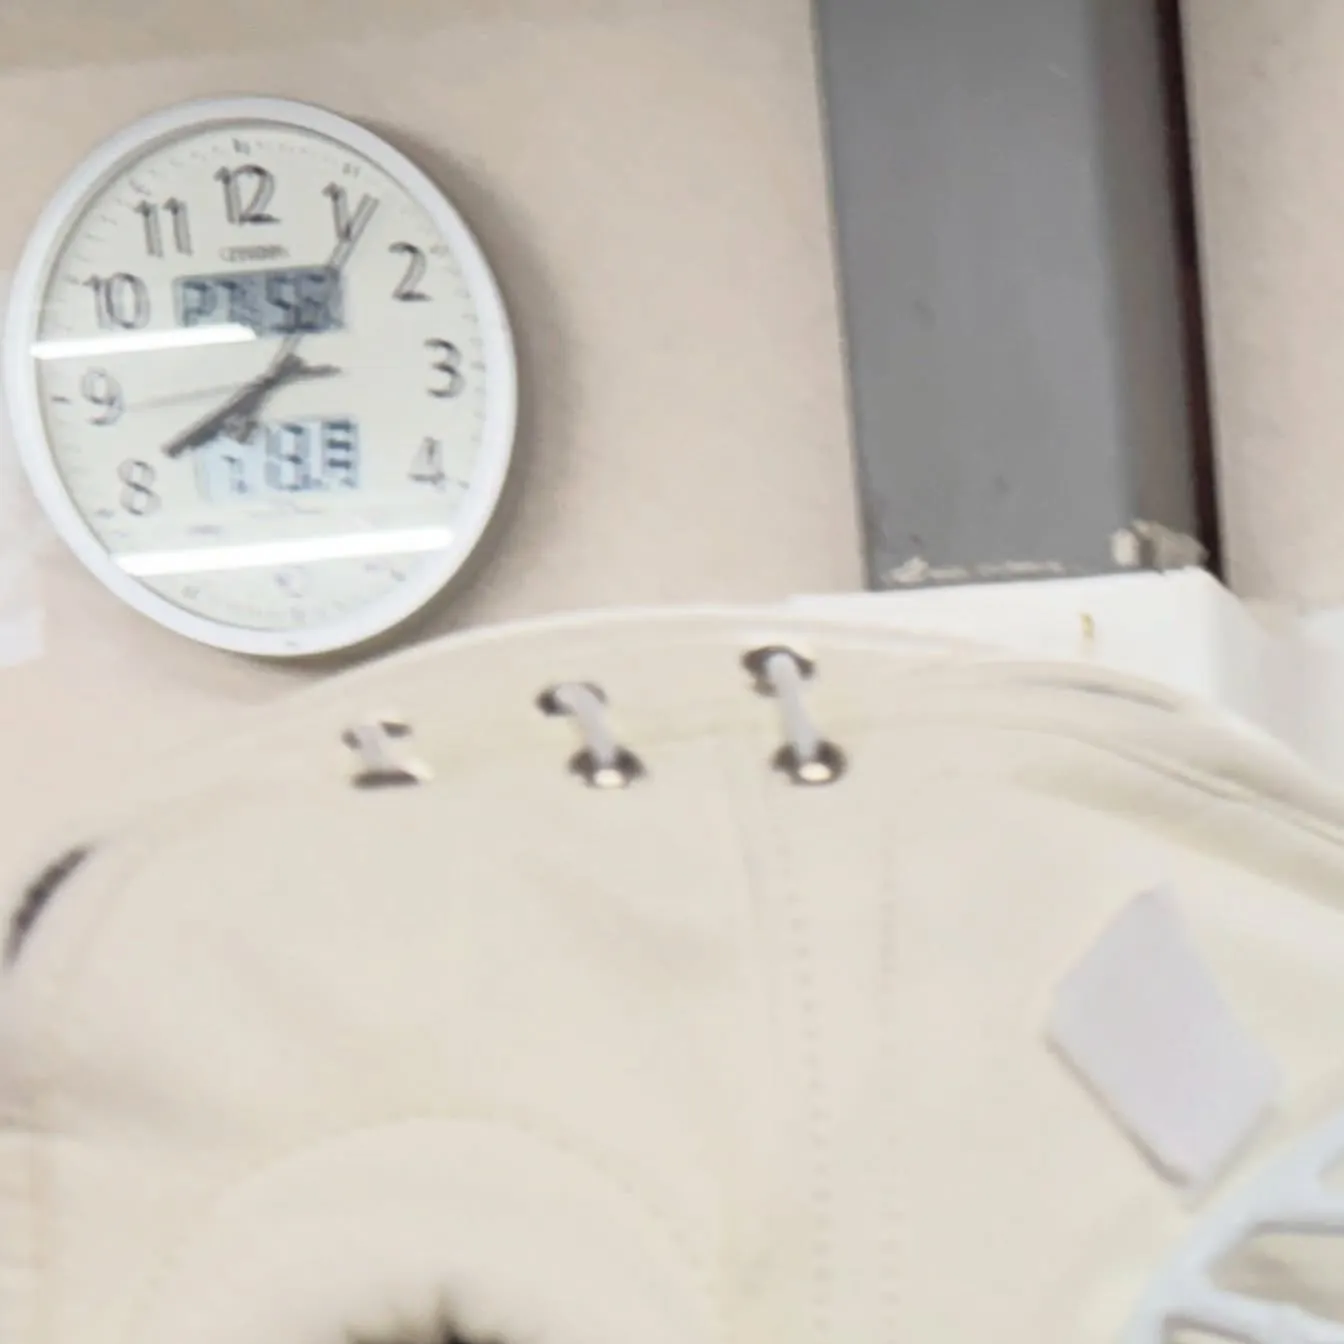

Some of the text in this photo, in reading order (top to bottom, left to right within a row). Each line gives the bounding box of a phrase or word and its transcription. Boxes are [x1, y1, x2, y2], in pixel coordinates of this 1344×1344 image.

[214, 164, 281, 225] 12
[135, 197, 194, 257] 11
[388, 241, 433, 301] 2
[82, 272, 151, 330] 10
[80, 367, 124, 425] 9
[424, 338, 467, 398] 3
[117, 458, 162, 517] 8
[408, 436, 447, 490] 4
